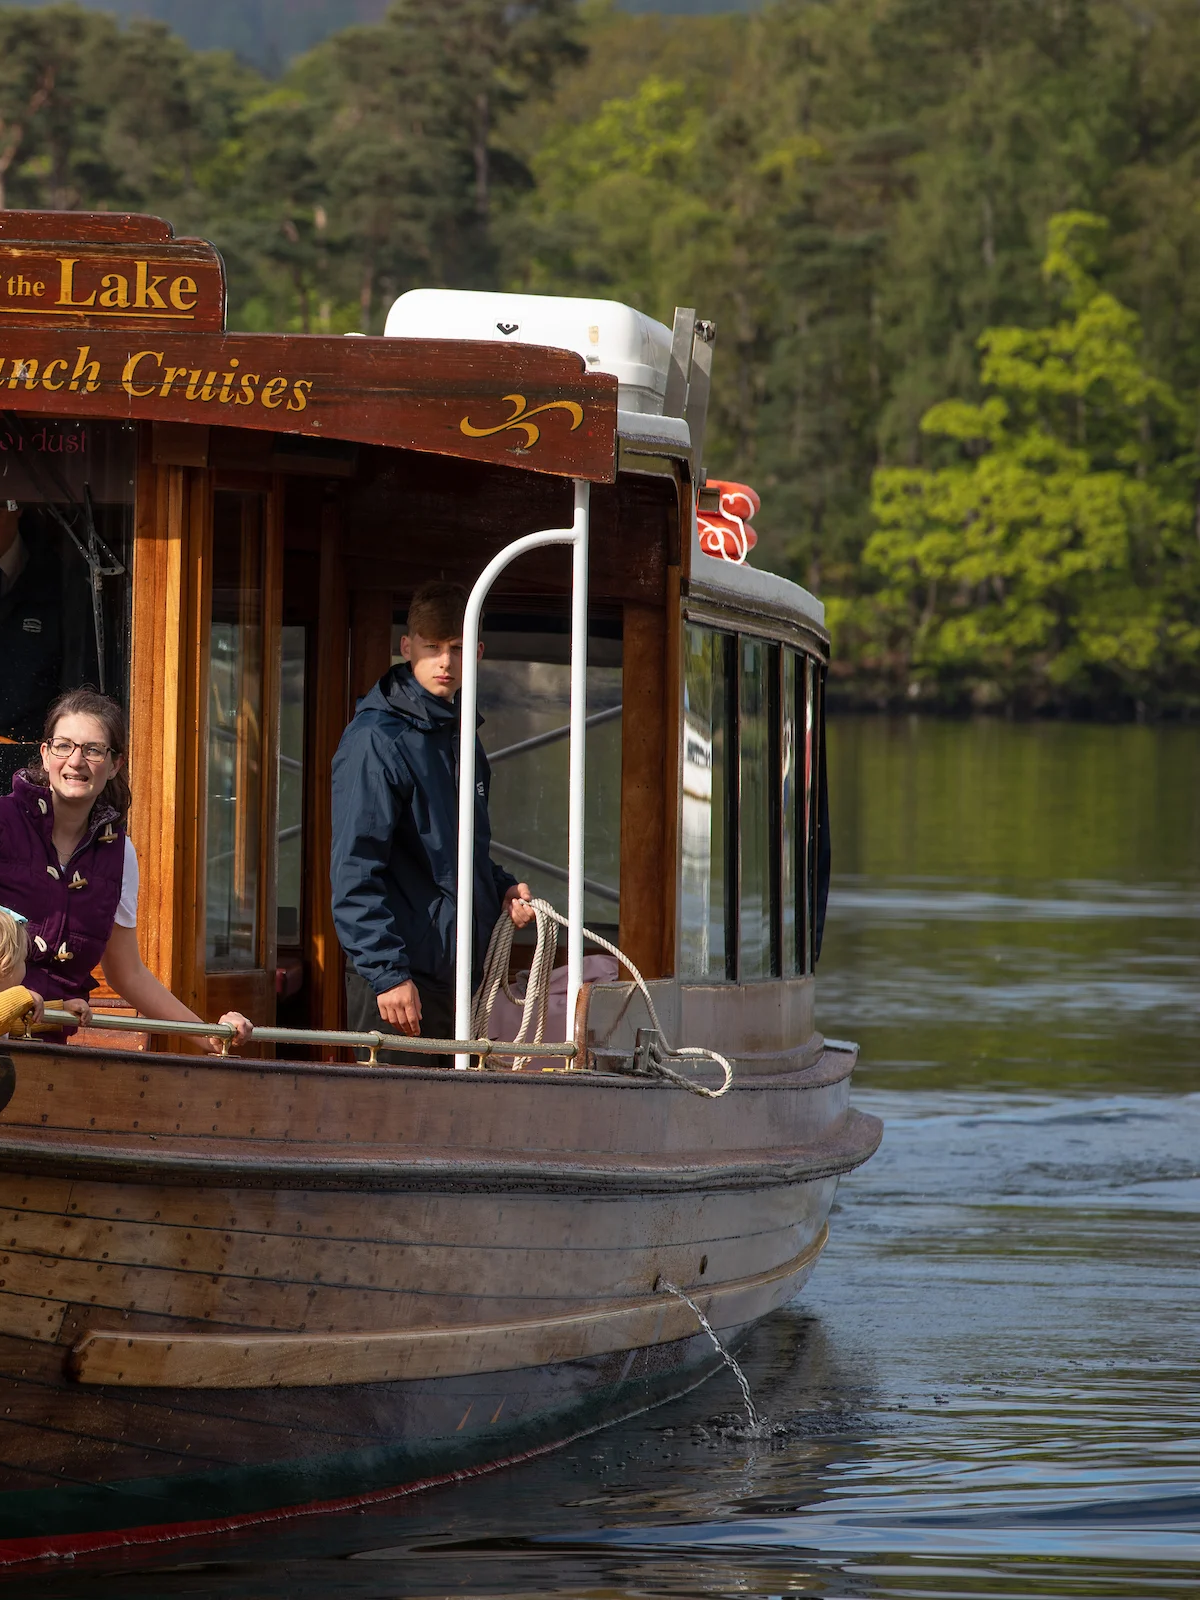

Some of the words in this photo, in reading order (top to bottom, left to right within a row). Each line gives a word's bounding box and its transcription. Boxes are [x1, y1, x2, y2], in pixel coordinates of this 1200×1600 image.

[8, 275, 46, 297] the
[54, 258, 198, 311] Lake
[121, 350, 314, 412] Cruises
